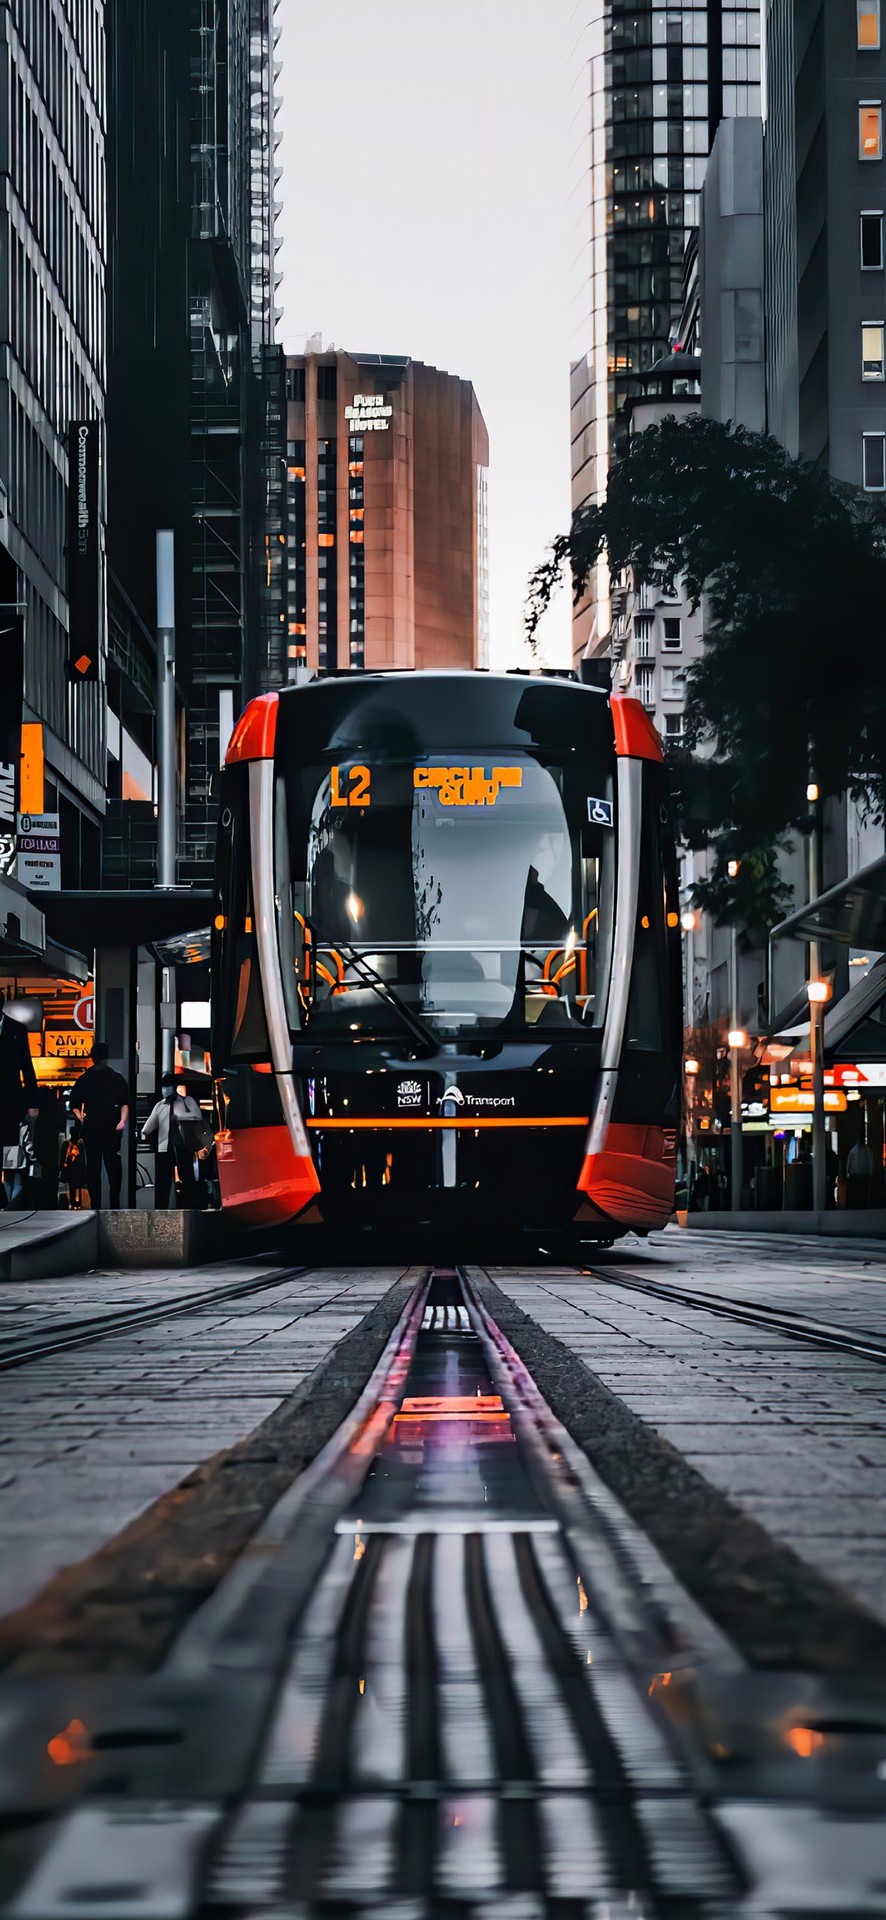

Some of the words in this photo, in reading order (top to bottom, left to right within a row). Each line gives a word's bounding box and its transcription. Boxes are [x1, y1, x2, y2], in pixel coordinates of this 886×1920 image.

[330, 765, 371, 807] L2
[397, 1094, 422, 1104] NSW
[465, 1094, 516, 1106] Transport
